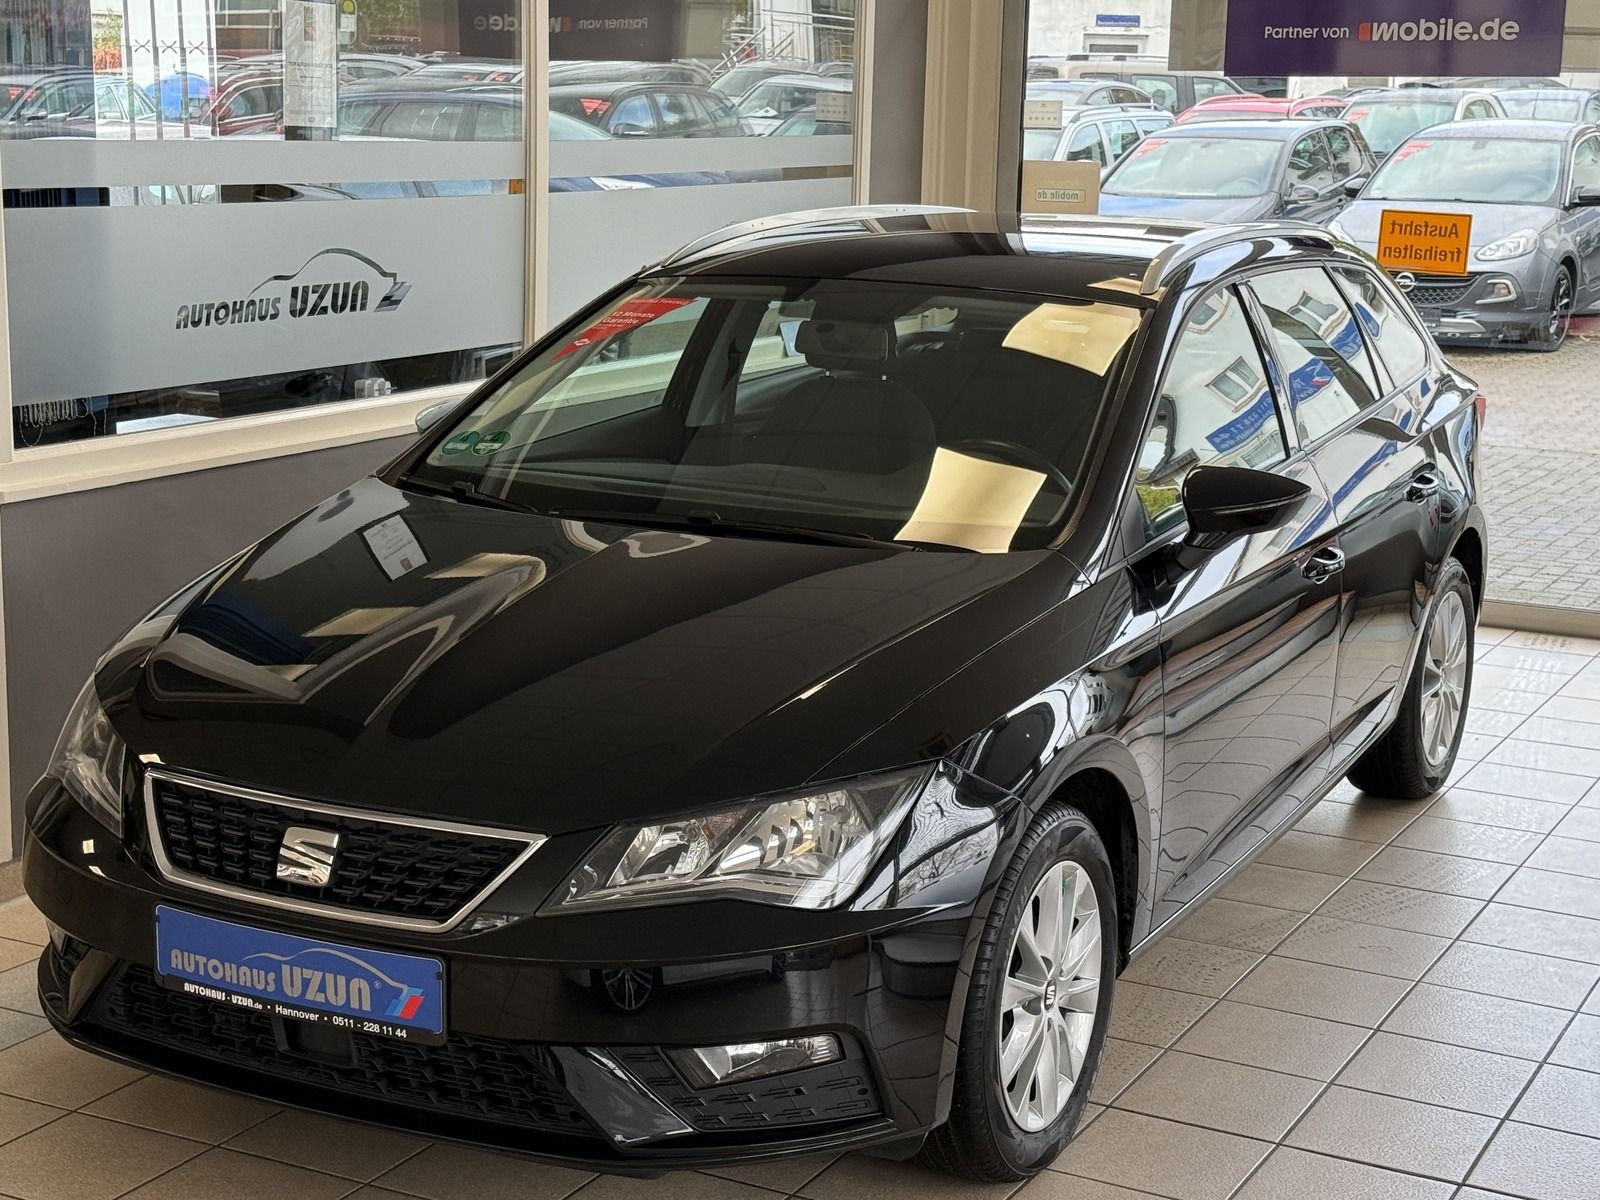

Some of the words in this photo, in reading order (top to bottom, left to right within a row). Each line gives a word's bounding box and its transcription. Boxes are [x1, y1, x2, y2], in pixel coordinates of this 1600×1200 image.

[1264, 26, 1318, 39] Partner
[1322, 27, 1350, 39] von
[1371, 18, 1520, 41] mobile.de
[175, 297, 281, 330] AUTOHAUS
[288, 280, 370, 318] UZUN
[170, 948, 276, 993] AUTOHAUS
[281, 963, 372, 1012] UZUN
[184, 982, 226, 1001] AUTOHAUS
[276, 1003, 319, 1021] Hannover
[332, 1015, 354, 1028] 0511
[363, 1021, 380, 1033] 228
[382, 1025, 392, 1036] 11
[395, 1028, 407, 1039] 44
